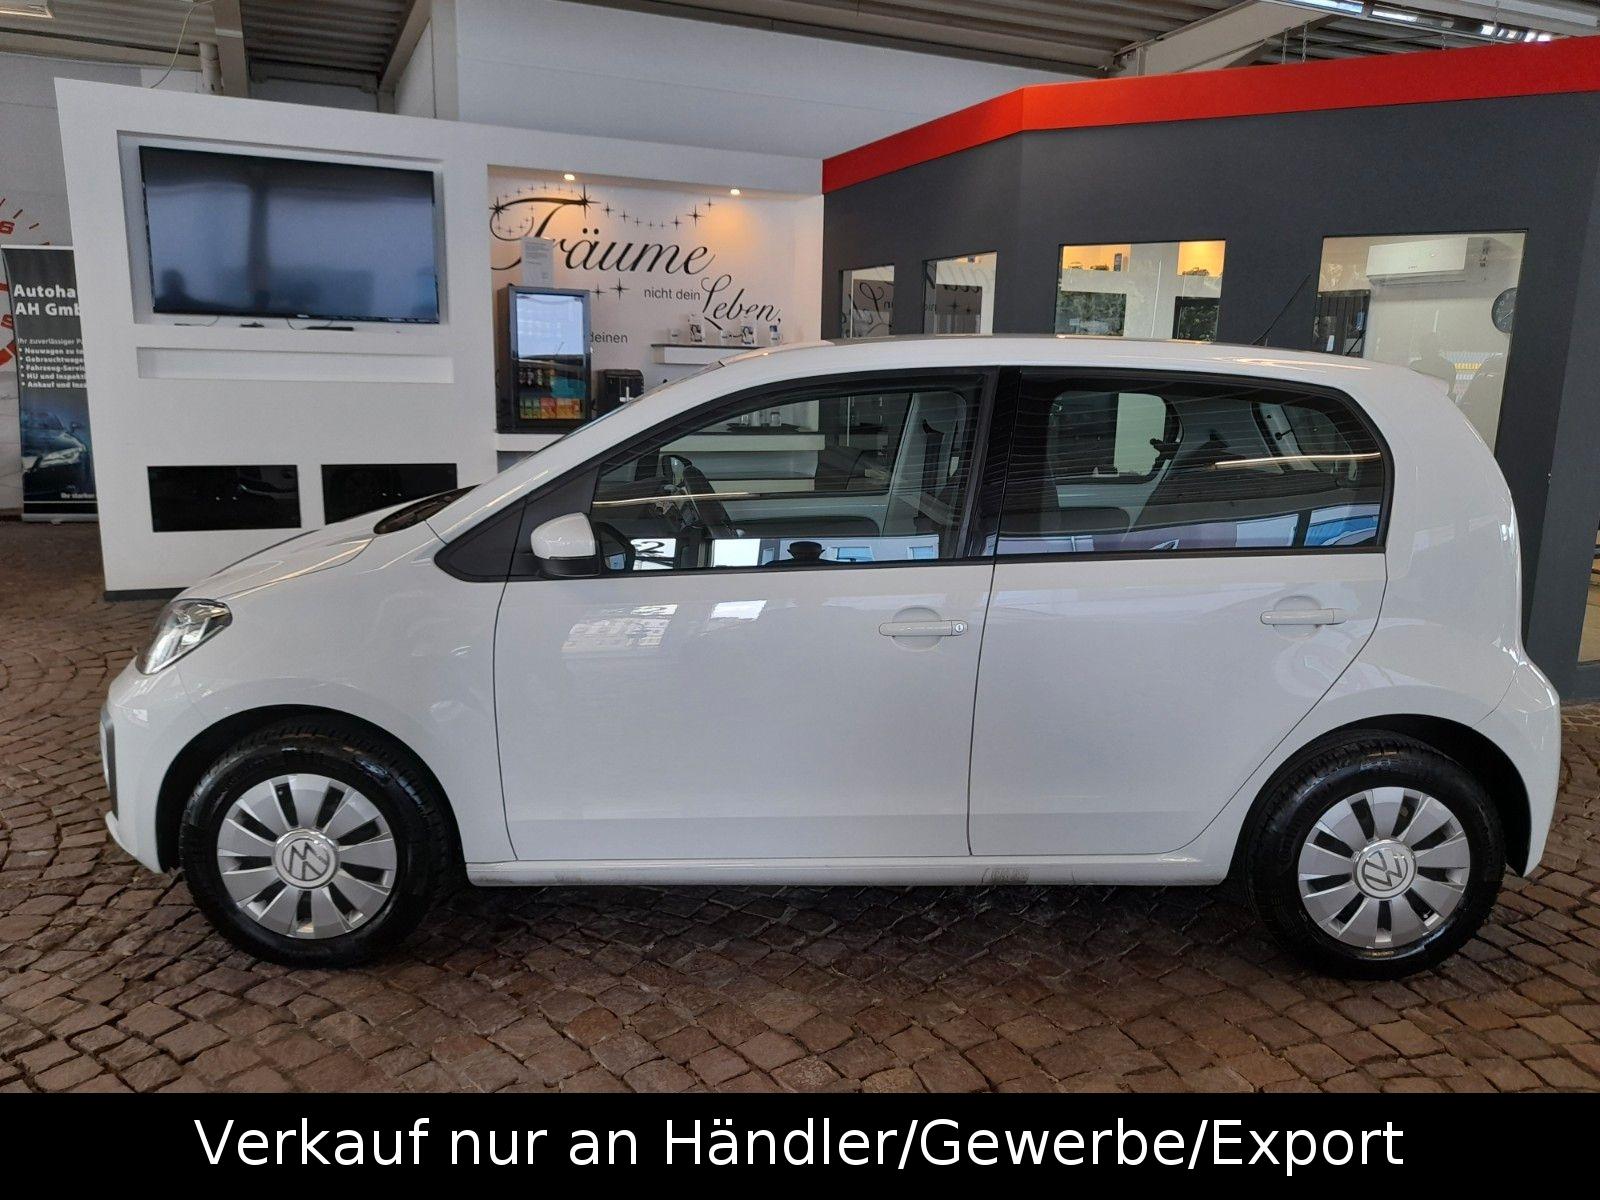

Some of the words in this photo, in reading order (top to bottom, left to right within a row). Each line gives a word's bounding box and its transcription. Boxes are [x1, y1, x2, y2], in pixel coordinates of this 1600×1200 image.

[14, 284, 76, 298] Autoha
[644, 288, 674, 300] nicht
[676, 289, 700, 300] dein
[15, 302, 40, 316] AH
[590, 331, 628, 344] deinen
